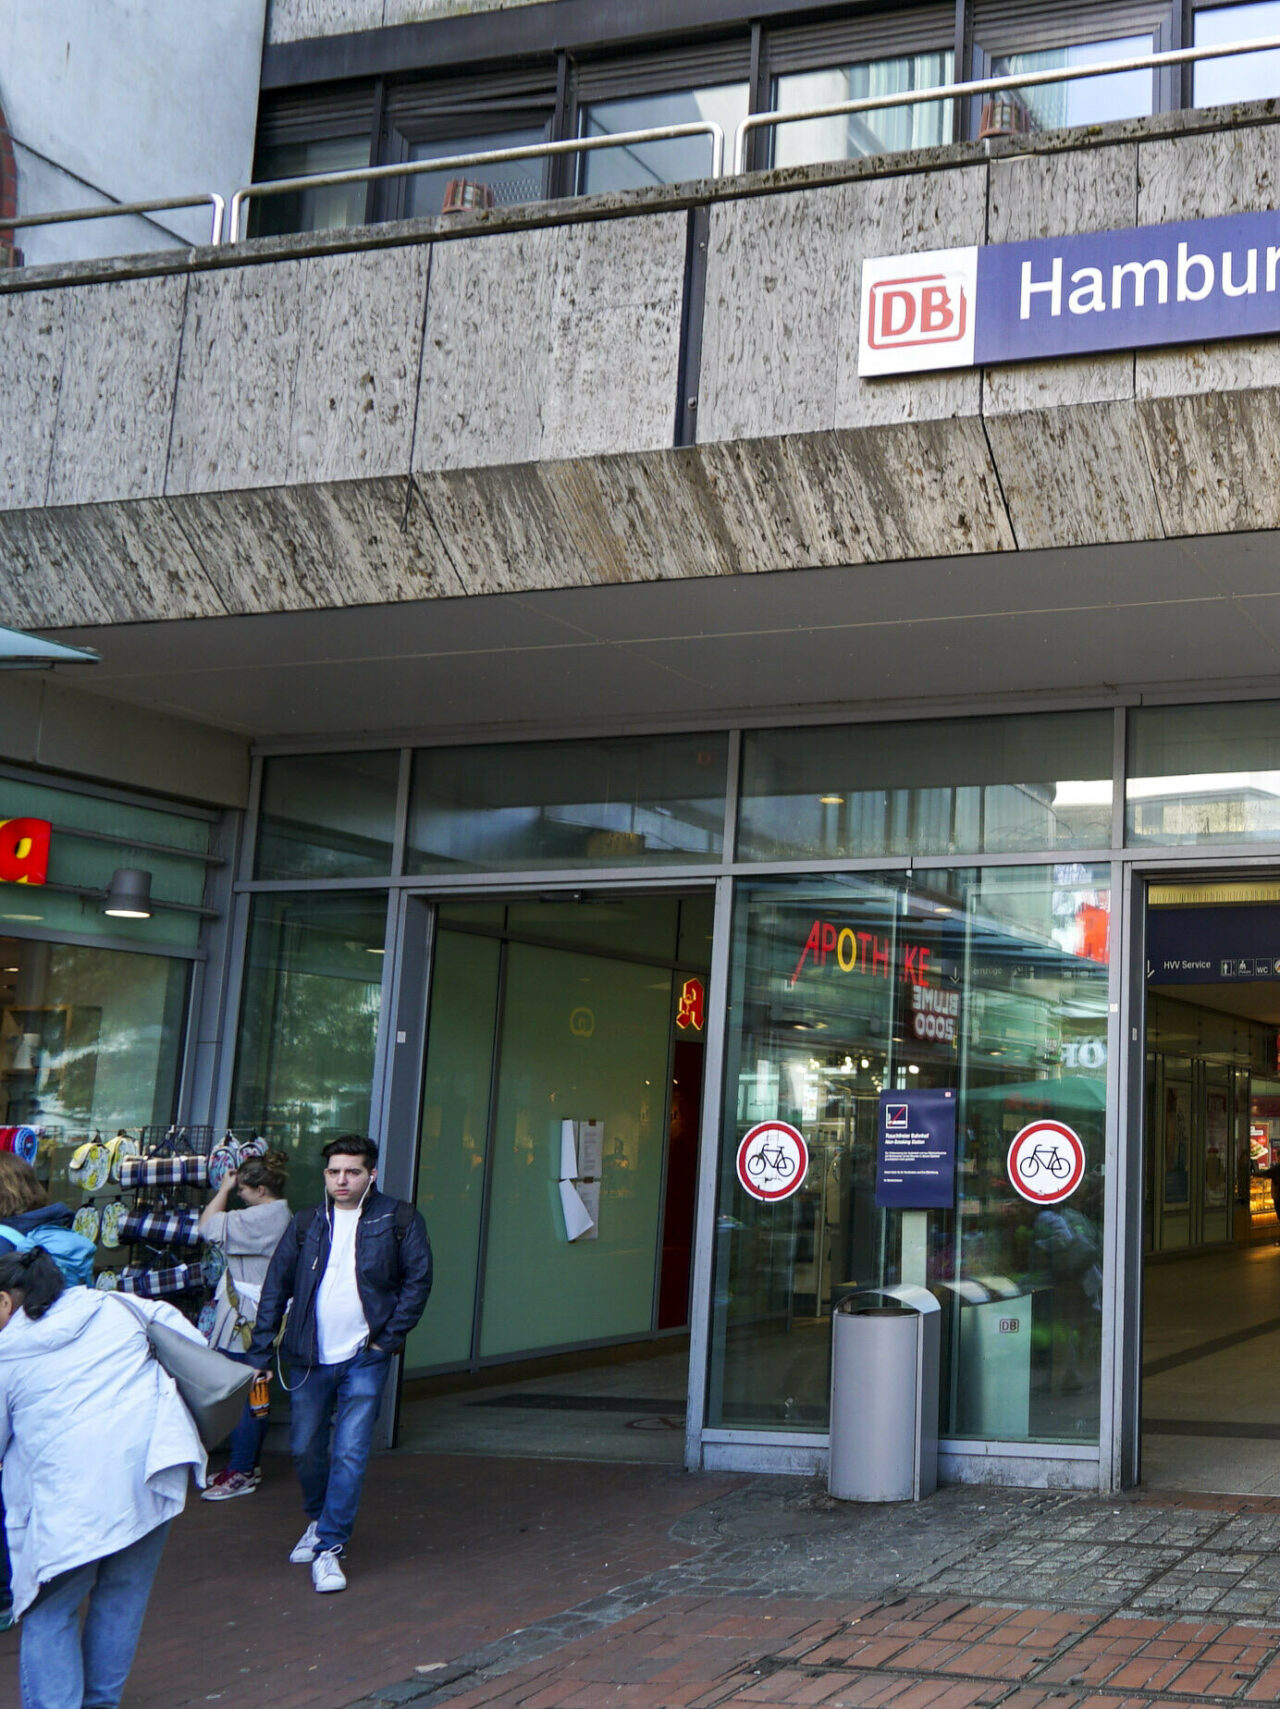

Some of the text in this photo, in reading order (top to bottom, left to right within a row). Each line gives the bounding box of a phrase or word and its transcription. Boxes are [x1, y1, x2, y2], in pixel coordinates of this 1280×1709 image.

[880, 284, 956, 338] DB
[791, 919, 931, 988] APOTHKE
[1163, 959, 1211, 969] HVV Service
[1001, 1320, 1018, 1332] DB
